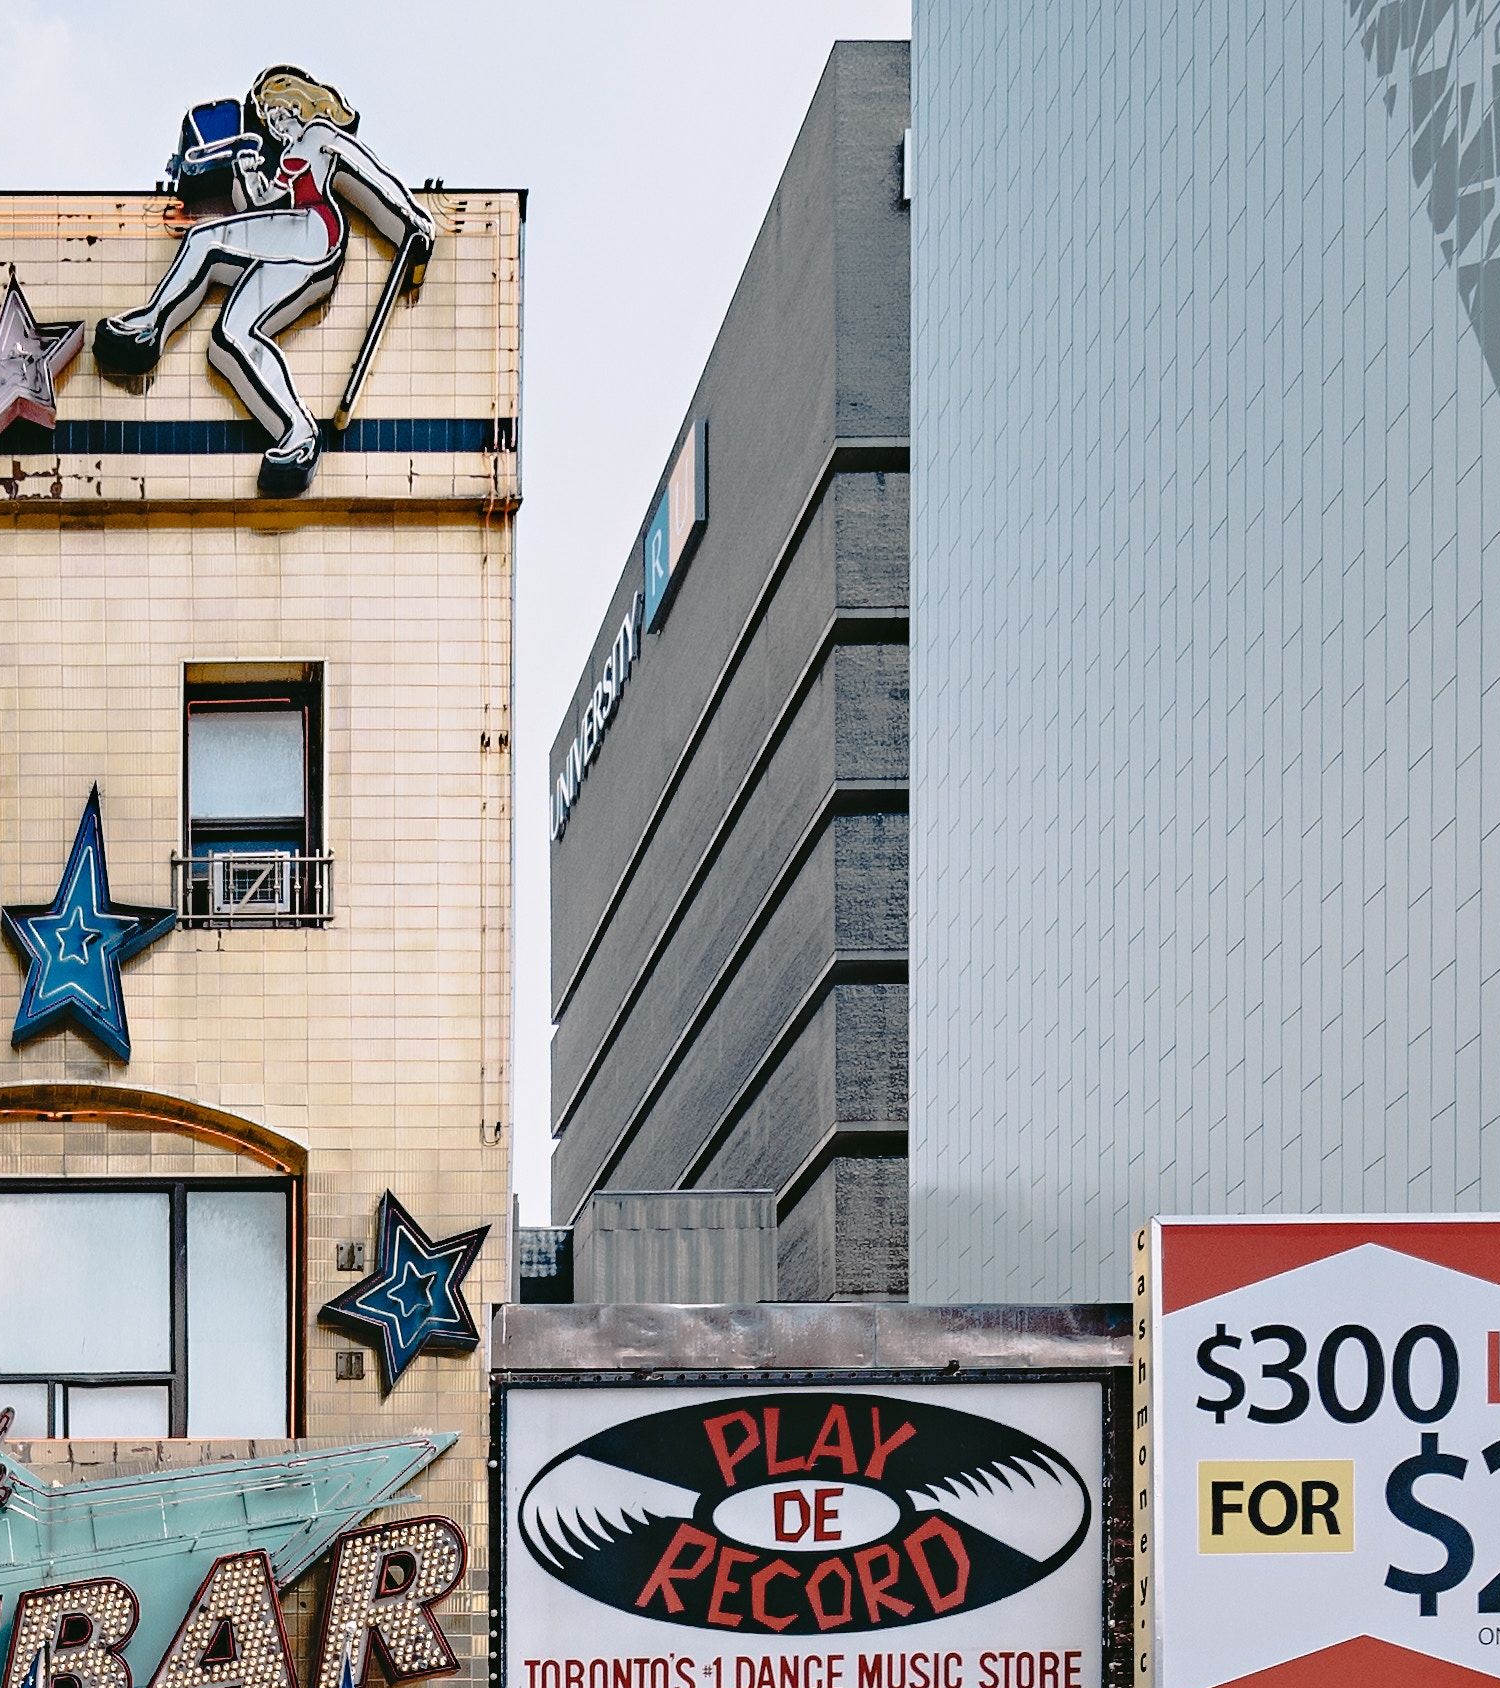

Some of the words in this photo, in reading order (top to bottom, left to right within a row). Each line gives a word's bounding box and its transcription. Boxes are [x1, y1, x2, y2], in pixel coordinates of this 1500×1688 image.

[549, 590, 642, 841] UNIVERSITY
[1195, 1323, 1461, 1425] $300
[703, 1403, 918, 1487] PLAY
[773, 1488, 844, 1543] DE
[1210, 1479, 1341, 1536] FOR
[635, 1517, 971, 1632] RECORD
